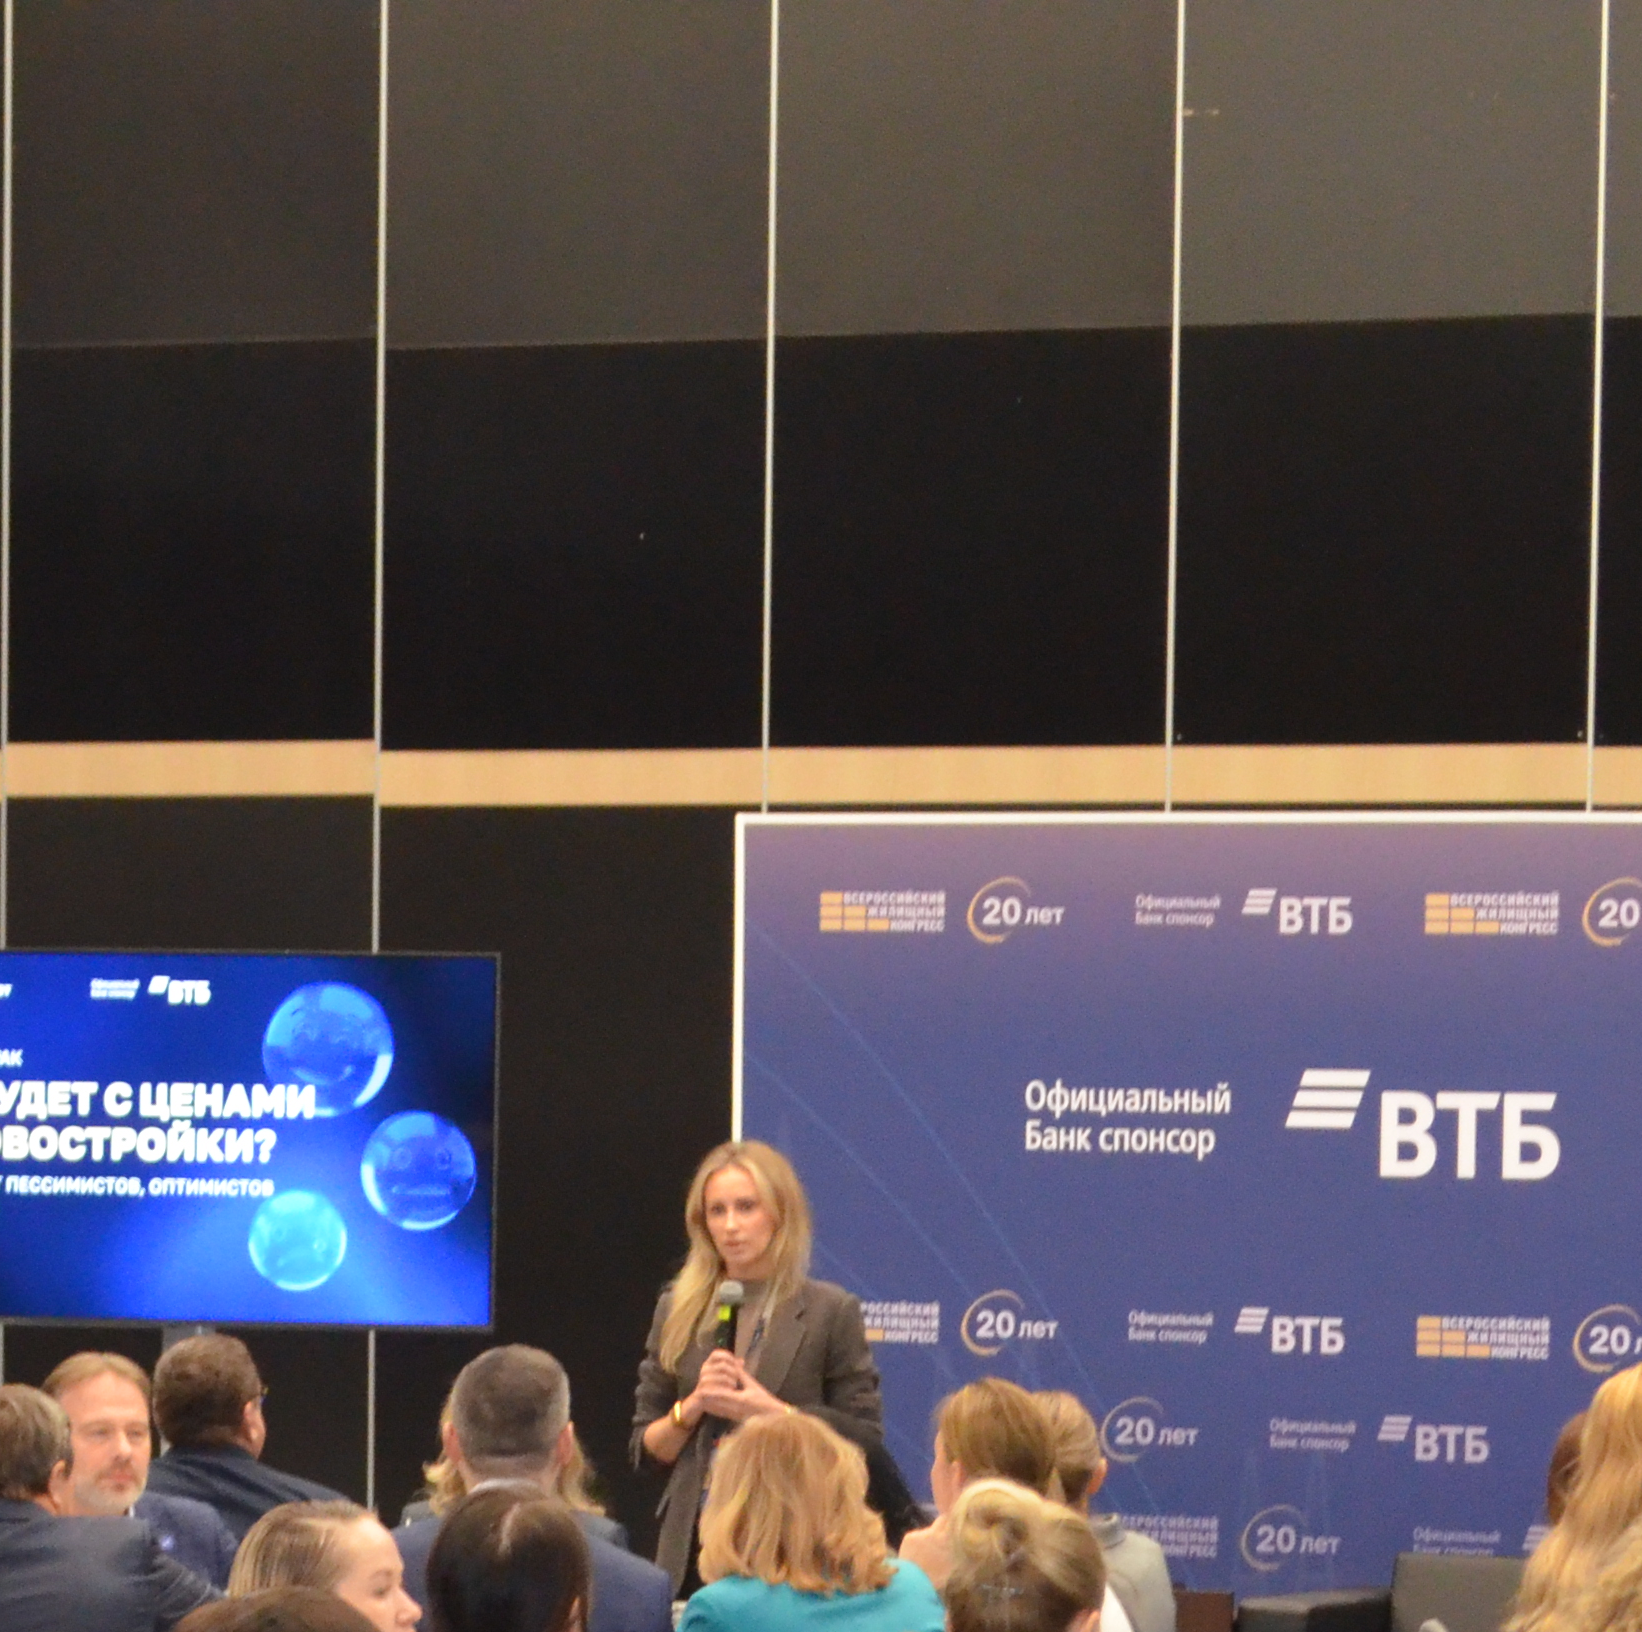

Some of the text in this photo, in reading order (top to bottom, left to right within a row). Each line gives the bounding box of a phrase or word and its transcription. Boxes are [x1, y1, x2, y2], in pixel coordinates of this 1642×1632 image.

[982, 898, 1064, 927] 20 лет
[1135, 894, 1220, 911] Официальный
[1278, 897, 1353, 934] ВТБ
[1598, 899, 1639, 928] 20
[890, 919, 944, 932] КОНГРЕСС
[1135, 912, 1215, 928] Банк спонсор
[1500, 921, 1559, 935] КОНГРЕСС
[167, 979, 211, 1005] ВТБ
[103, 1081, 132, 1115] С
[140, 1084, 316, 1122] ЦЕНАМИ
[1025, 1079, 1231, 1118] Официальный
[1025, 1122, 1215, 1160] Банк спонсор
[1379, 1091, 1560, 1180] ВТБ
[5, 1176, 145, 1198] ПЕССИМИСТОВ,
[149, 1178, 275, 1198] ОПТИМИСТОВ
[860, 1300, 940, 1315] РОССИЙСКИЙ
[1128, 1308, 1214, 1328] Официальный
[976, 1310, 1058, 1339] 20 лет
[1128, 1328, 1207, 1345] Банк спонсор
[1271, 1316, 1345, 1354] ВТБ
[1491, 1345, 1549, 1360] КОНГРЕСС
[1589, 1325, 1630, 1353] 20
[1116, 1417, 1199, 1446] 20 лет
[1269, 1416, 1356, 1435] Официальный
[1269, 1435, 1349, 1452] Банк спонсор
[1414, 1424, 1489, 1463] ВТБ
[1257, 1526, 1340, 1555] 20 лет
